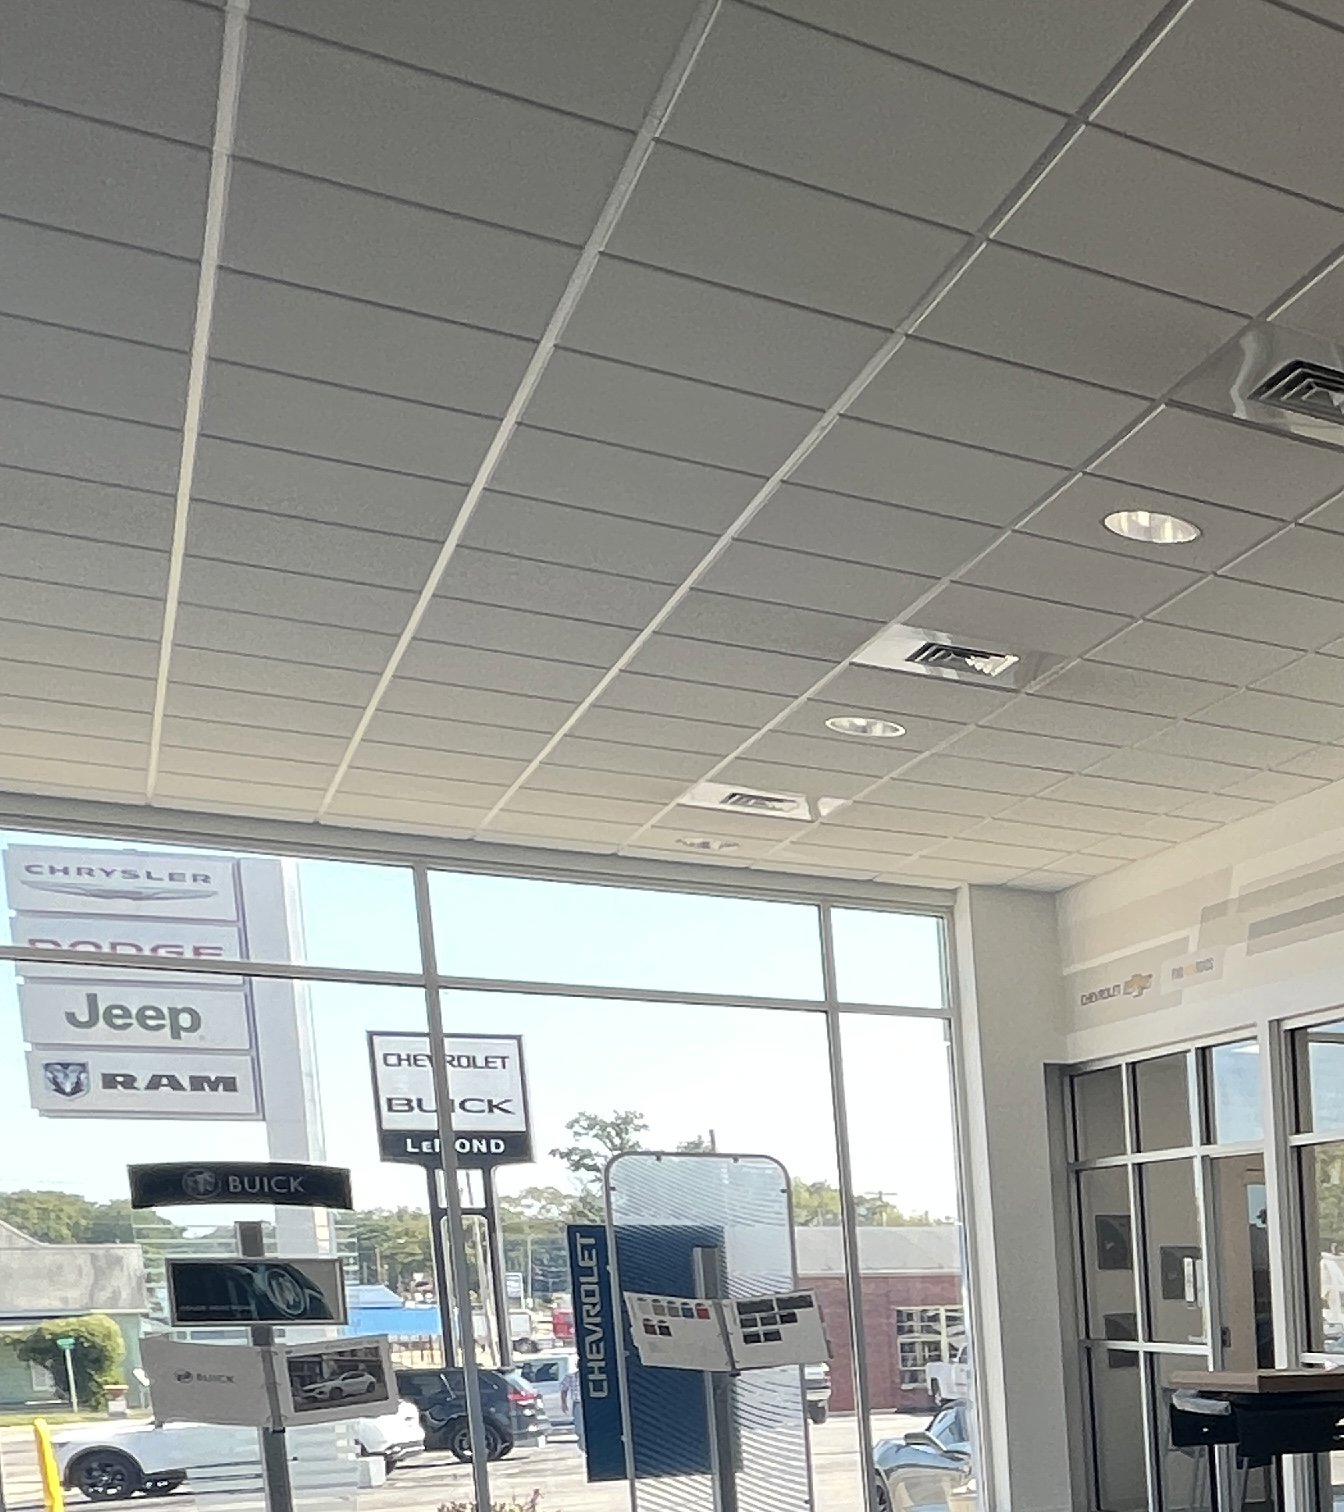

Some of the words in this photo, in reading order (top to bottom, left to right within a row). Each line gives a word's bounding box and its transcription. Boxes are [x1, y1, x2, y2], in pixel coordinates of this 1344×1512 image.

[24, 864, 213, 885] CHRYSLER
[64, 992, 202, 1041] Jeep
[101, 1073, 239, 1092] RAM
[228, 1175, 306, 1193] BUICK
[575, 1232, 609, 1398] CHEVROLET
